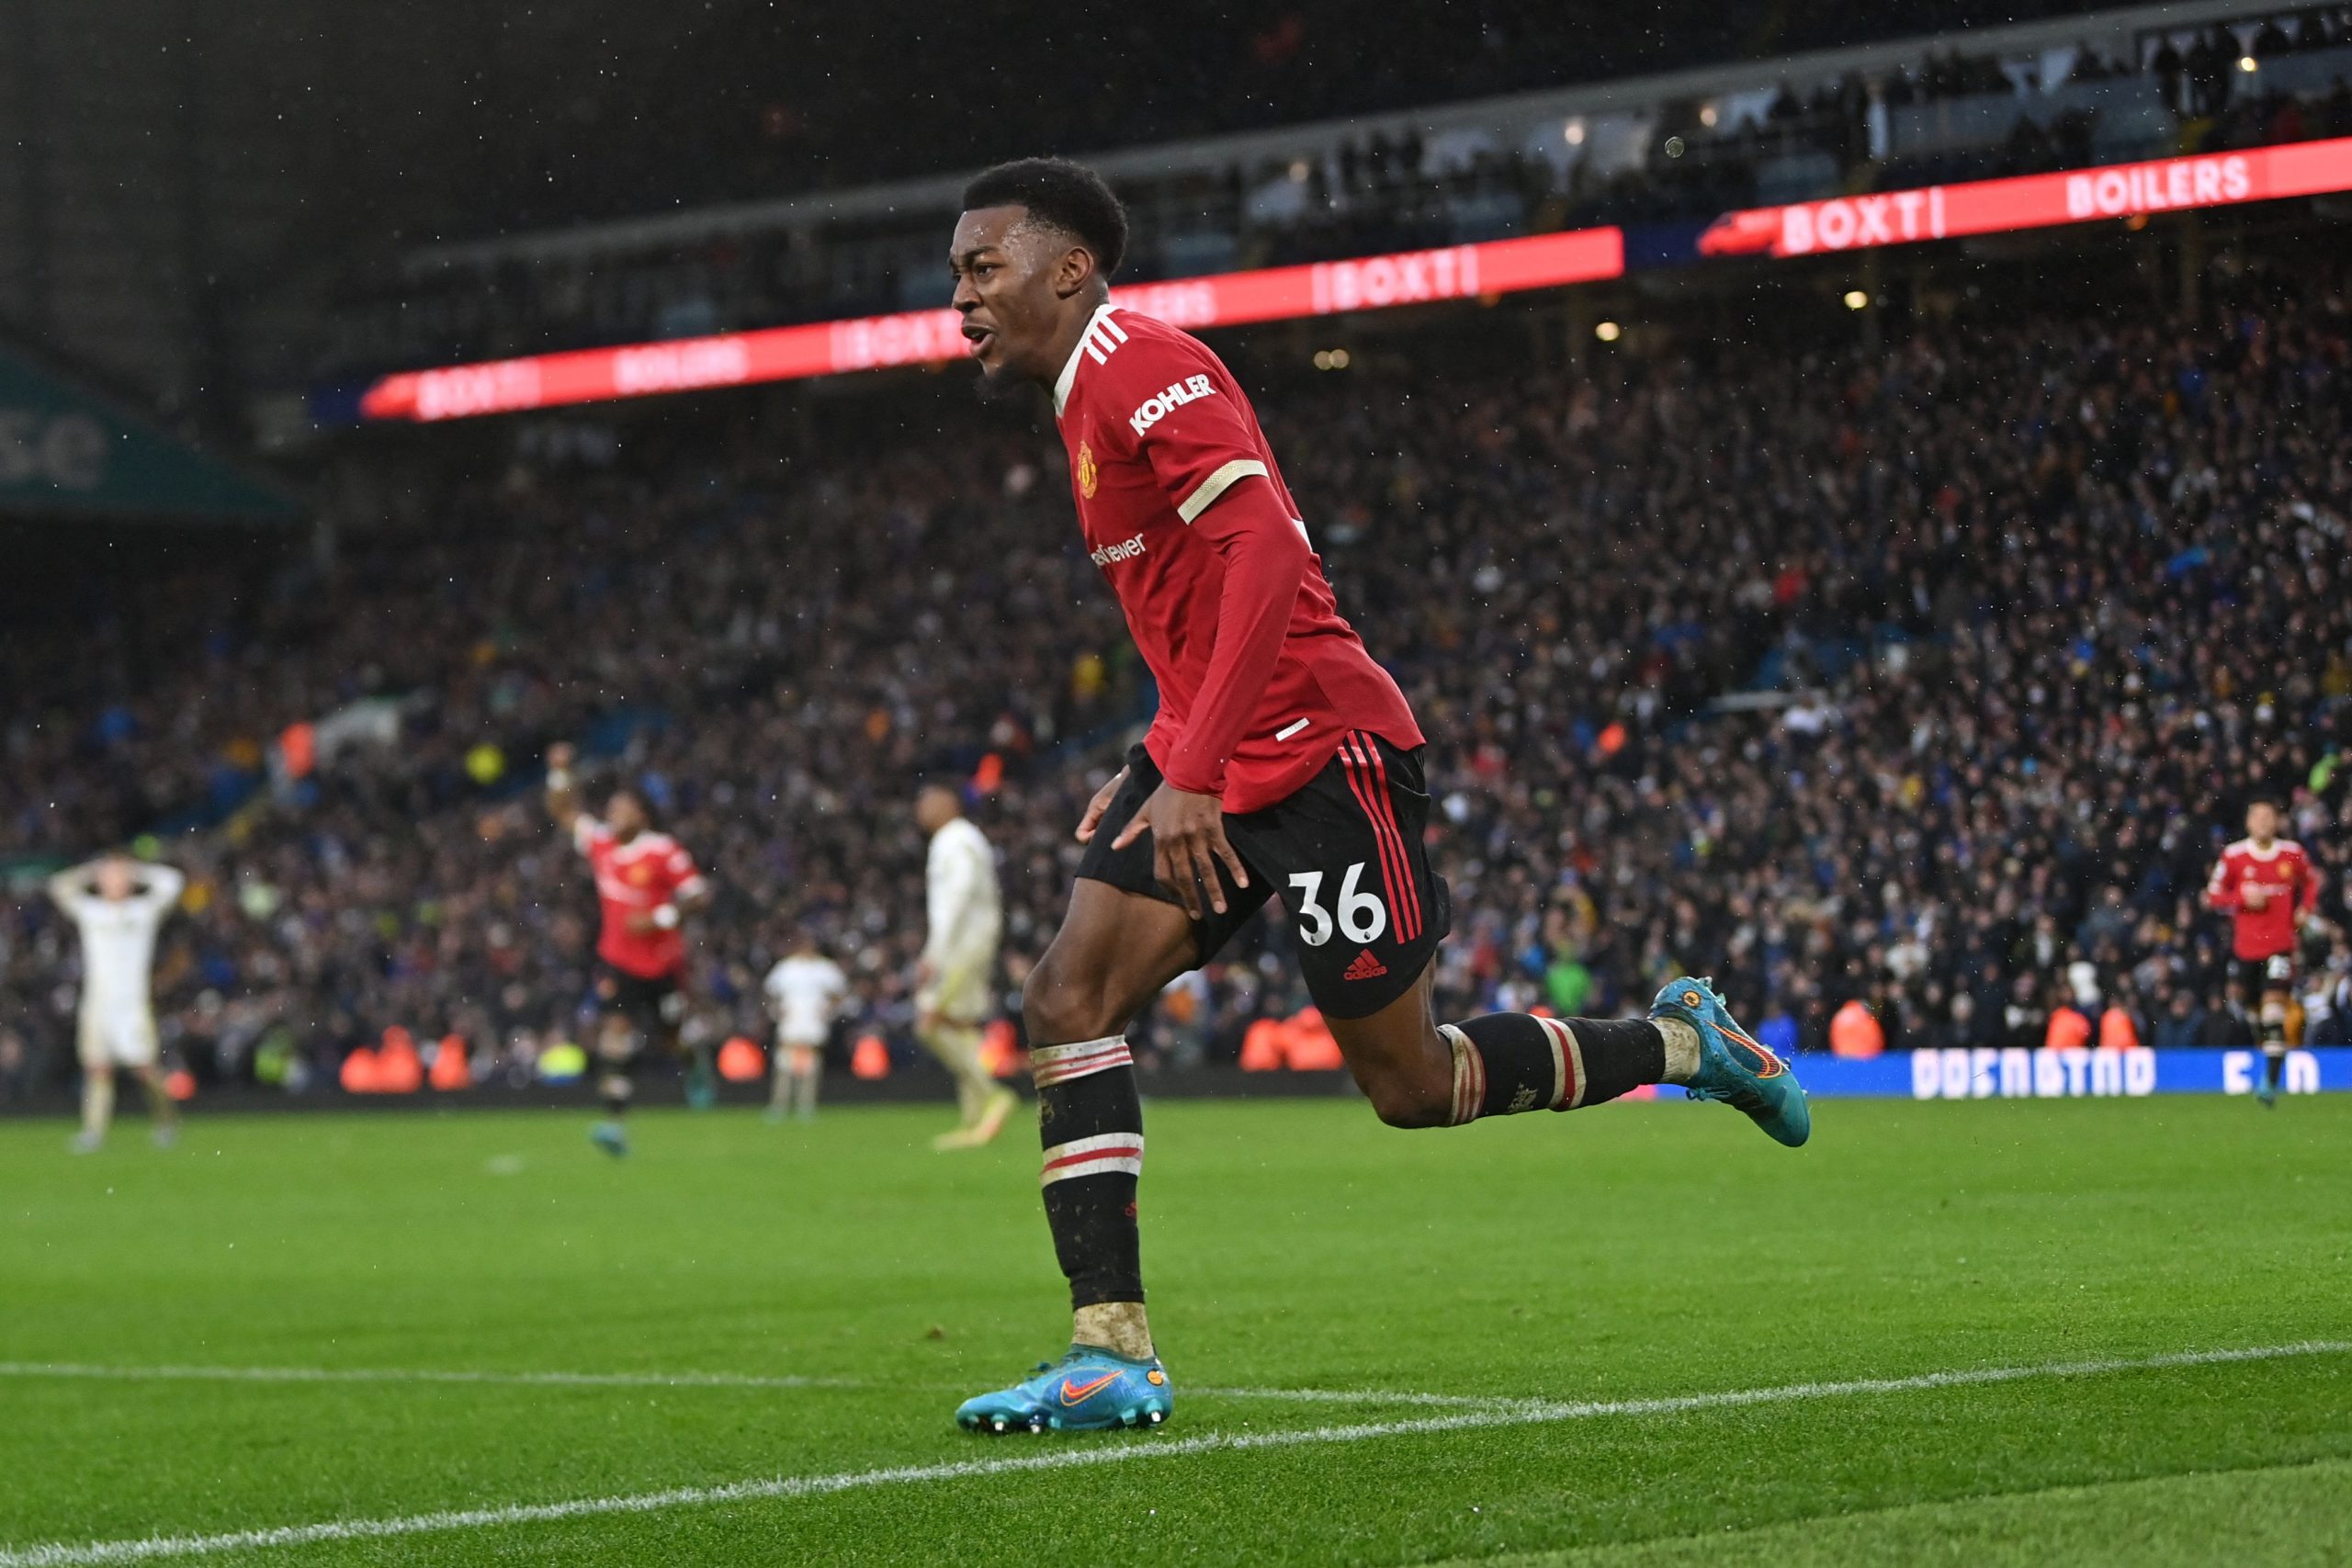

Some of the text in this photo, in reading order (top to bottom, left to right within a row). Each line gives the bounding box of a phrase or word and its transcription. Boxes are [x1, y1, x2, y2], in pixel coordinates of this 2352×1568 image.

[2068, 154, 2250, 220] BOILERS
[1129, 373, 1217, 437] KOHLER
[1288, 862, 1386, 946] 36
[1343, 965, 1387, 981] adidas
